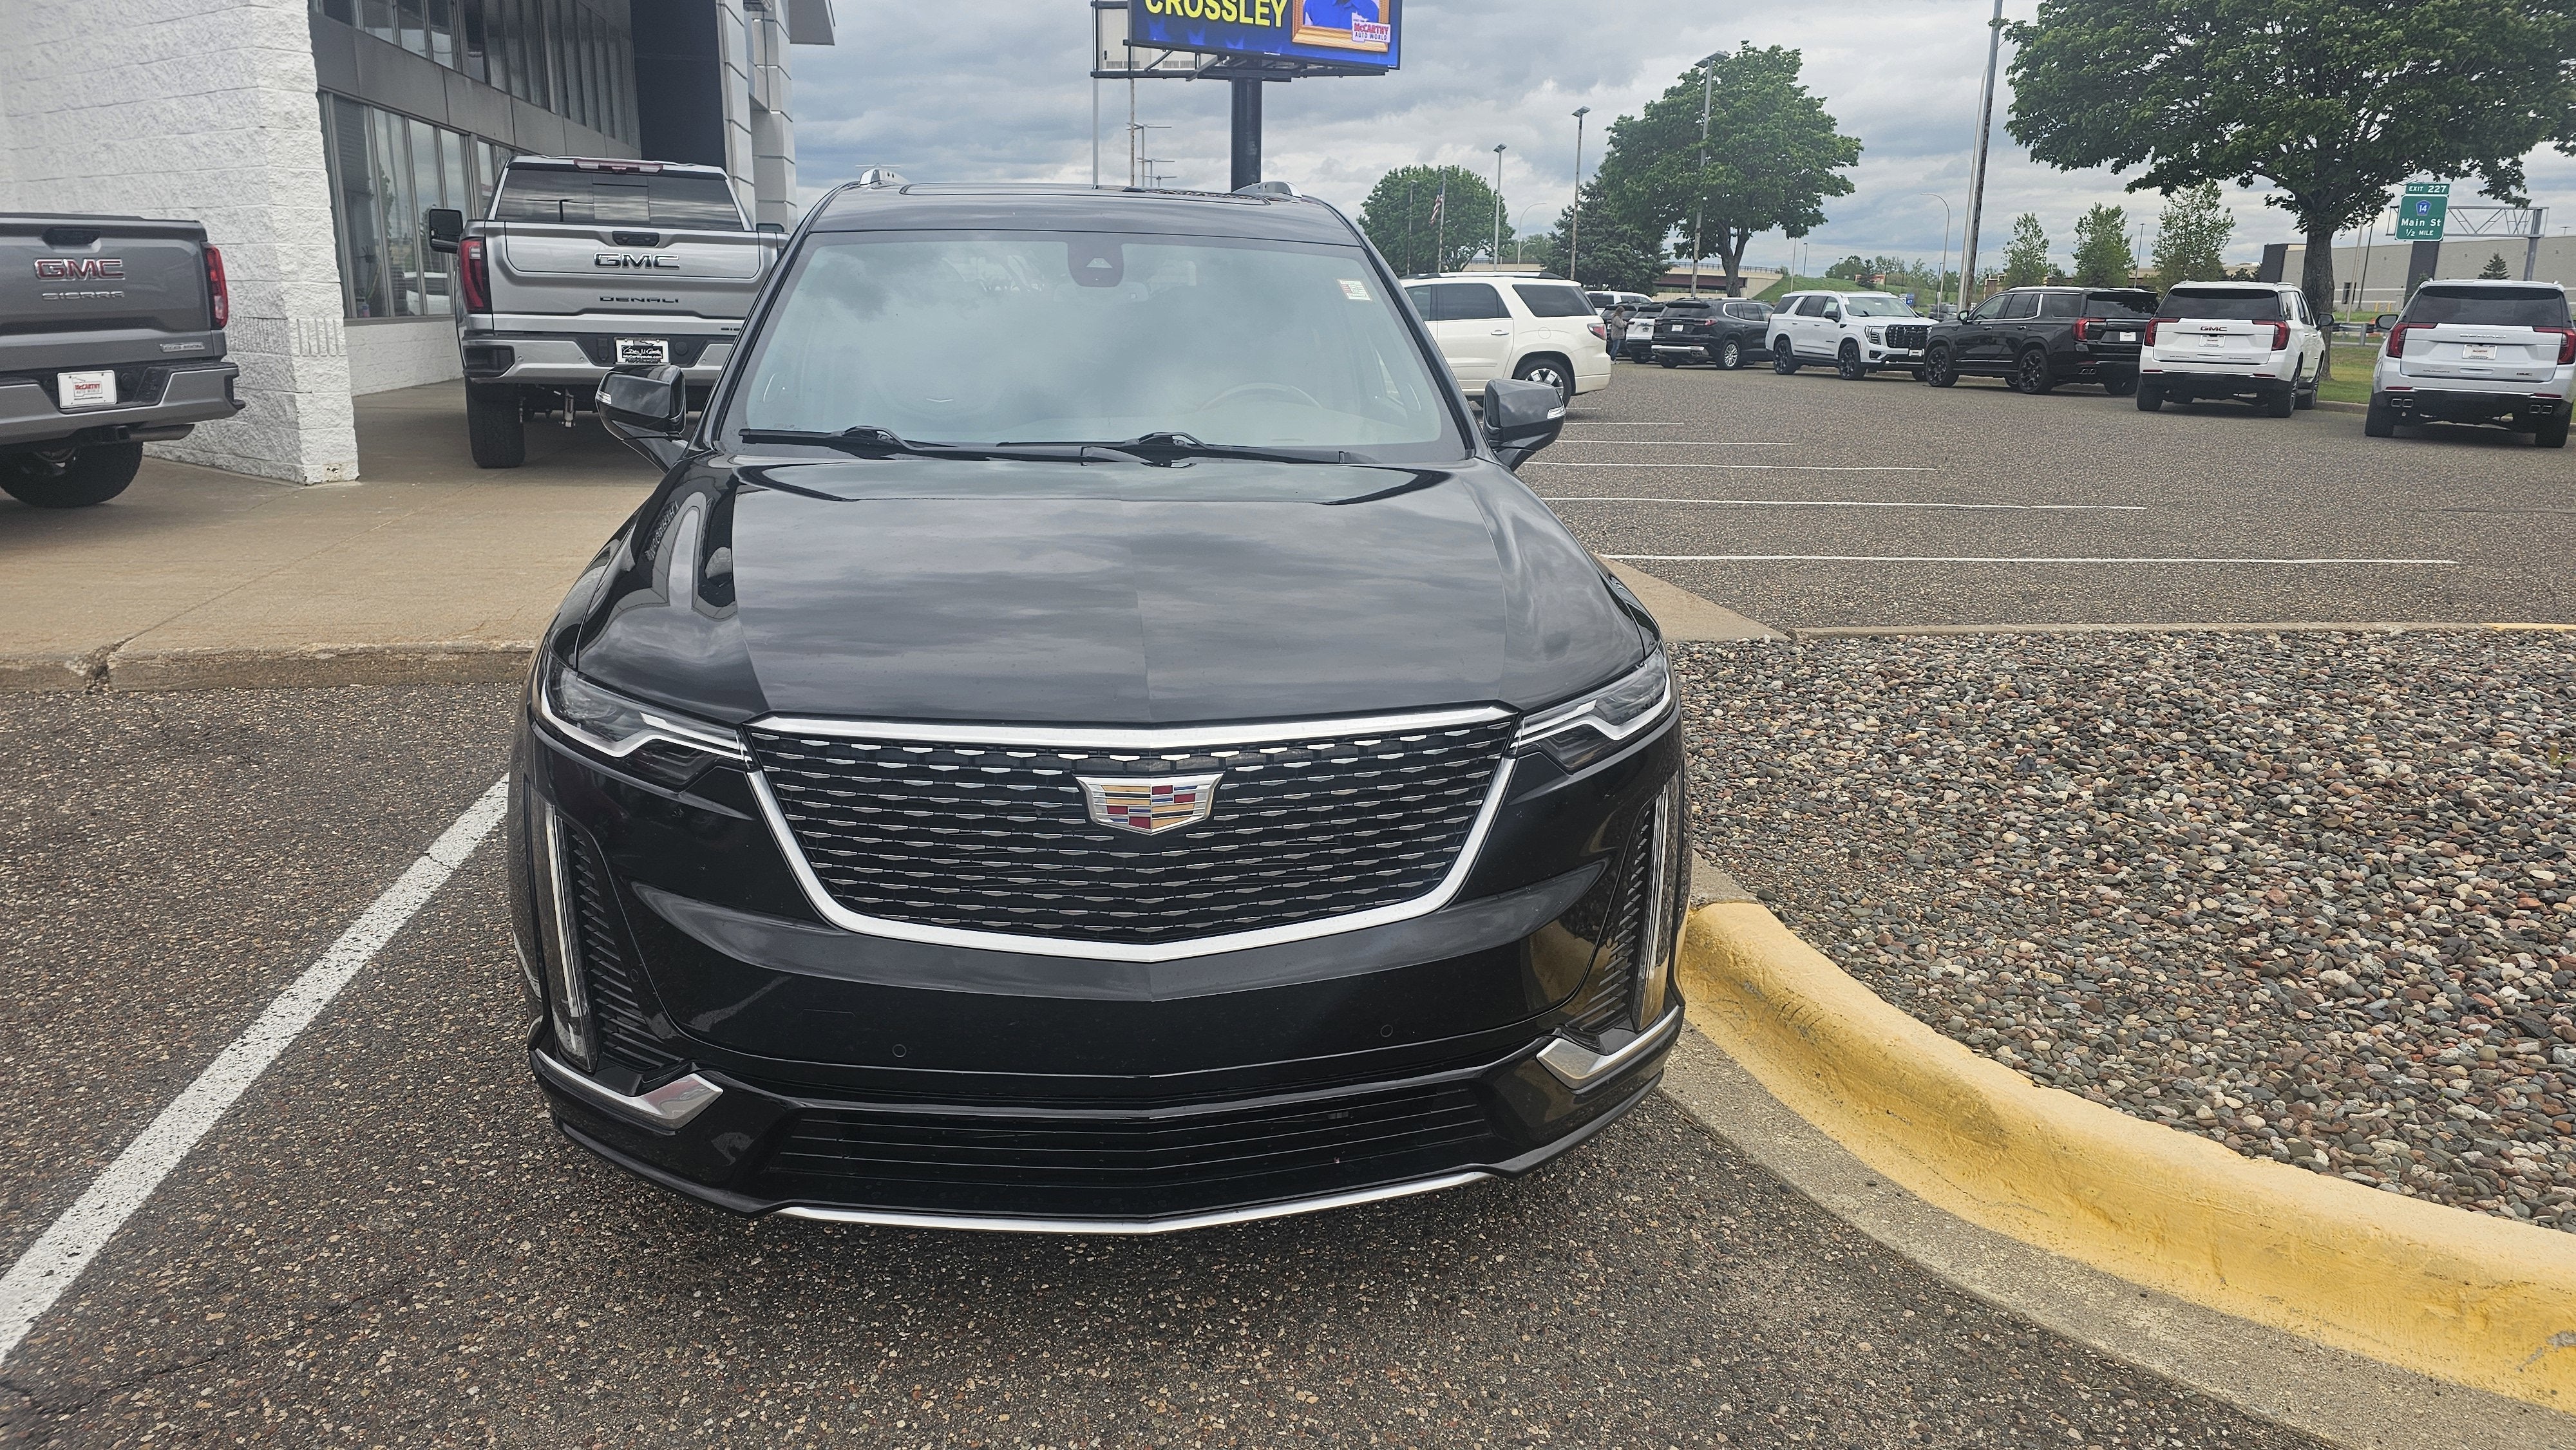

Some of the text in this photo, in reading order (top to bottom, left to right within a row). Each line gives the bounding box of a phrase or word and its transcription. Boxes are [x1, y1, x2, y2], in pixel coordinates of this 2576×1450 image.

[34, 259, 126, 281] GMC
[594, 252, 680, 270] GMC
[42, 291, 126, 301] SIERRA
